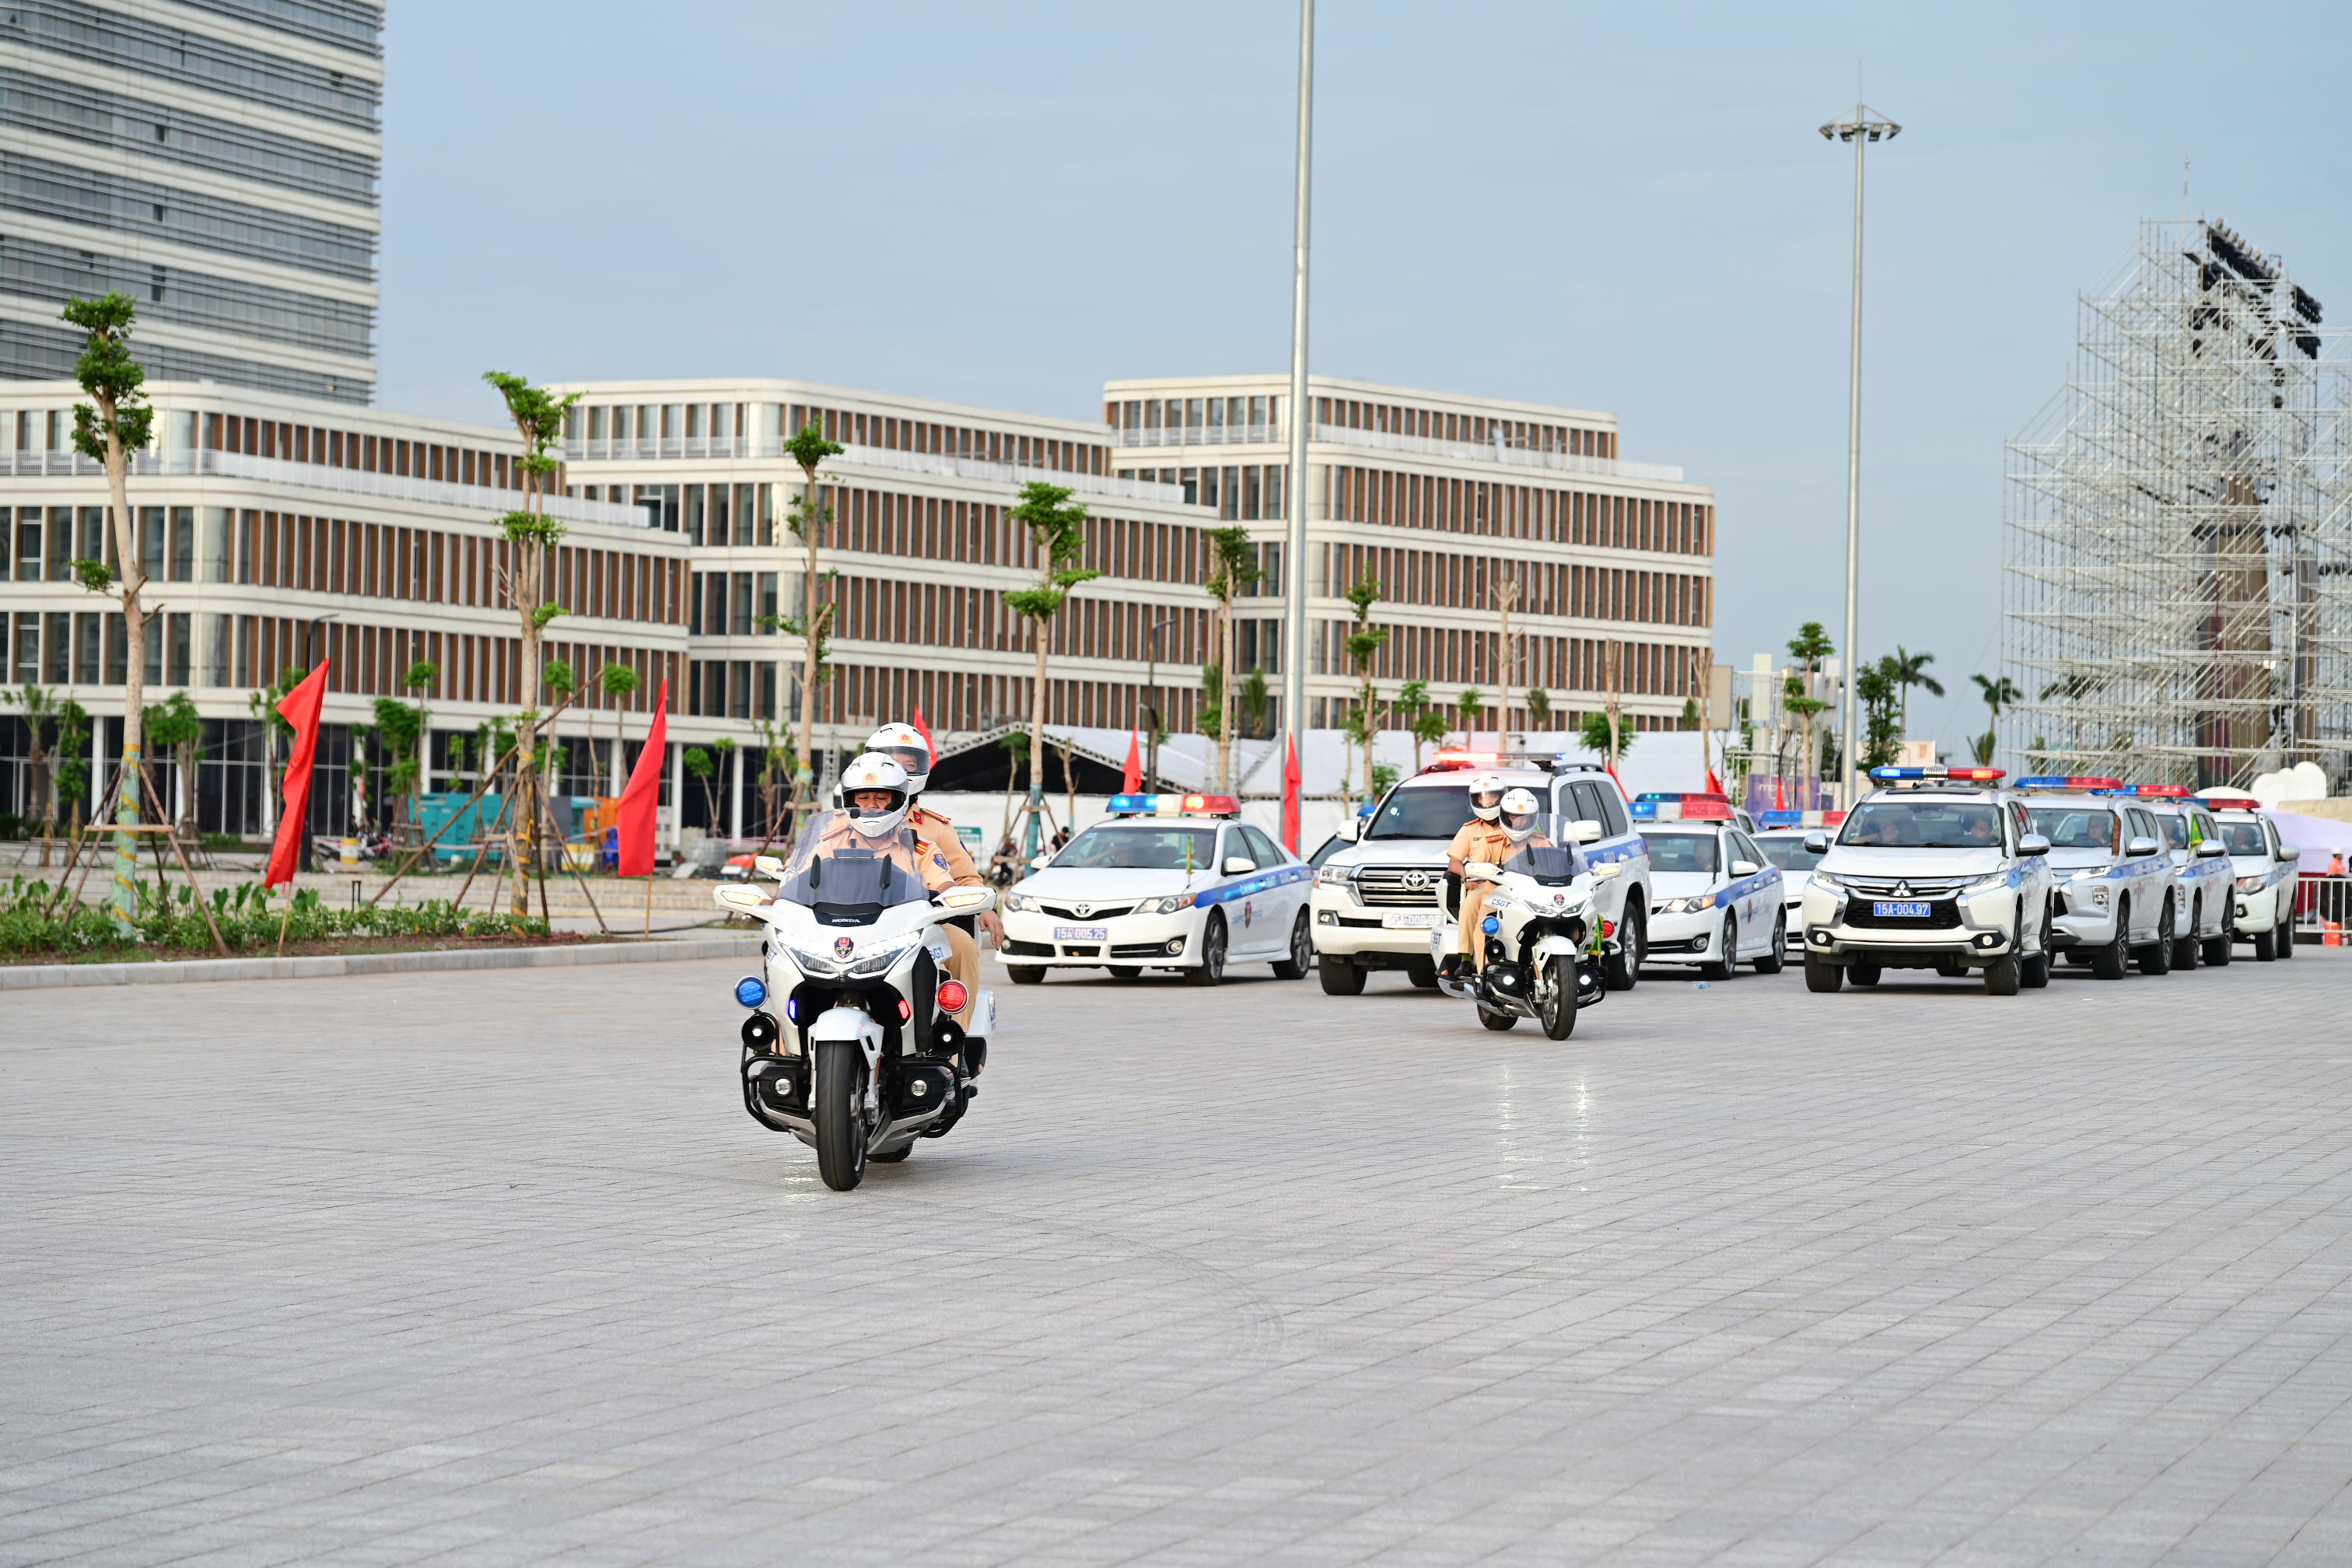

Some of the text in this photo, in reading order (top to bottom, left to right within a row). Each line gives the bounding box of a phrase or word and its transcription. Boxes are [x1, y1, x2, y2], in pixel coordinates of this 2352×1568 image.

[1491, 898, 1511, 908] CSGT
[1877, 904, 1929, 915] 15A-004.97
[927, 947, 945, 961] SGT
